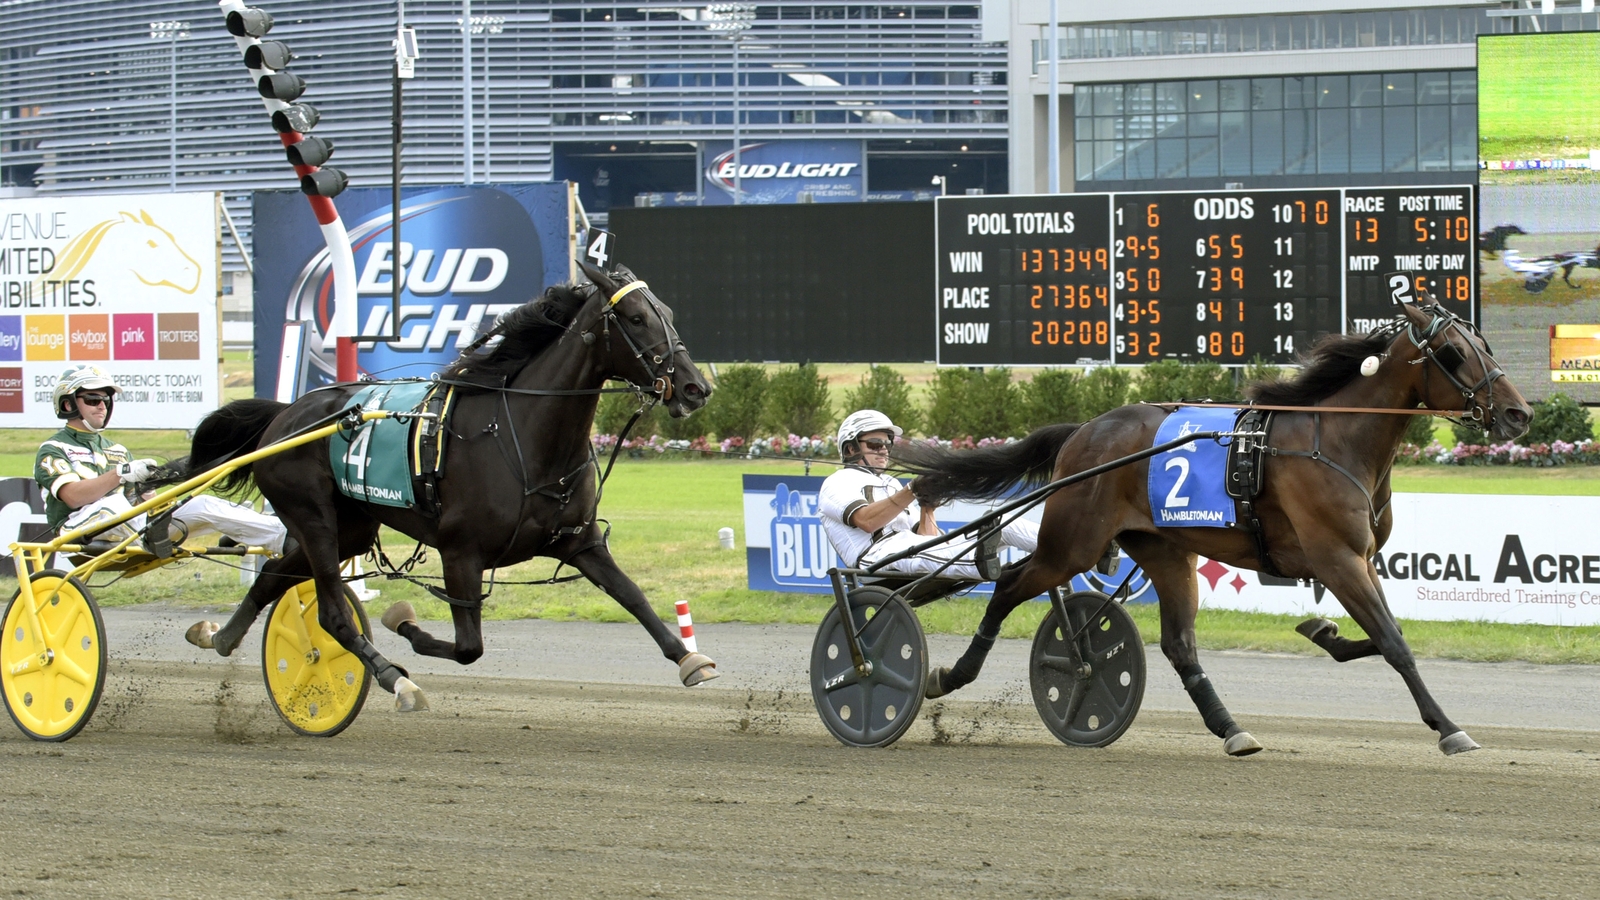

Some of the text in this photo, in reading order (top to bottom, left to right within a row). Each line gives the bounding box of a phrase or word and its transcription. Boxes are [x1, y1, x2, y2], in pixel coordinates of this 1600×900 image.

[718, 162, 858, 178] BUD LIGHT
[1194, 197, 1255, 220] ODDS
[1345, 196, 1385, 213] RACE
[1399, 195, 1463, 211] POST TIME
[967, 211, 1075, 235] POOL TOTALS
[1115, 203, 1160, 228] 1 6
[1272, 204, 1293, 224] 10
[1355, 217, 1378, 242] 13
[1414, 216, 1469, 242] 5:10
[588, 232, 608, 268] 4
[1115, 239, 1125, 258] 2
[1196, 238, 1206, 257] 6
[1273, 236, 1293, 256] 11
[357, 241, 509, 295] BUD
[949, 252, 983, 273] WIN
[1022, 248, 1108, 273] 137349
[1349, 255, 1380, 271] MTP
[1394, 254, 1465, 271] TIME OF DAY
[1115, 271, 1125, 290] 3
[1196, 270, 1206, 289] 7
[1273, 269, 1293, 288] 12
[1415, 275, 1469, 301] 5:18
[0, 279, 102, 308] IBILITIES.
[943, 287, 990, 309] PLACE
[1031, 285, 1108, 308] 27364
[1389, 275, 1413, 305] 2
[1115, 303, 1125, 321] 4
[1196, 302, 1206, 321] 8
[1273, 301, 1294, 321] 13
[26, 330, 64, 349] lounge
[71, 329, 107, 347] skybox
[121, 327, 145, 347] pink
[159, 330, 199, 343] TROTTERS
[944, 322, 990, 344] SHOW
[1031, 321, 1108, 345] 20208
[1115, 335, 1126, 354] 5
[1197, 334, 1207, 354] 9
[1273, 335, 1294, 354] 14
[35, 374, 202, 388] BOO PERIENCE TODAY!
[342, 425, 371, 480] 4
[1165, 456, 1190, 508] 2
[1160, 509, 1223, 521] HAMBLETONIAN
[775, 523, 838, 579] BLU
[1371, 551, 1480, 582] AGICAL
[1416, 586, 1510, 603] Standardbred
[1515, 589, 1576, 608] Training
[825, 674, 845, 689] LZR
